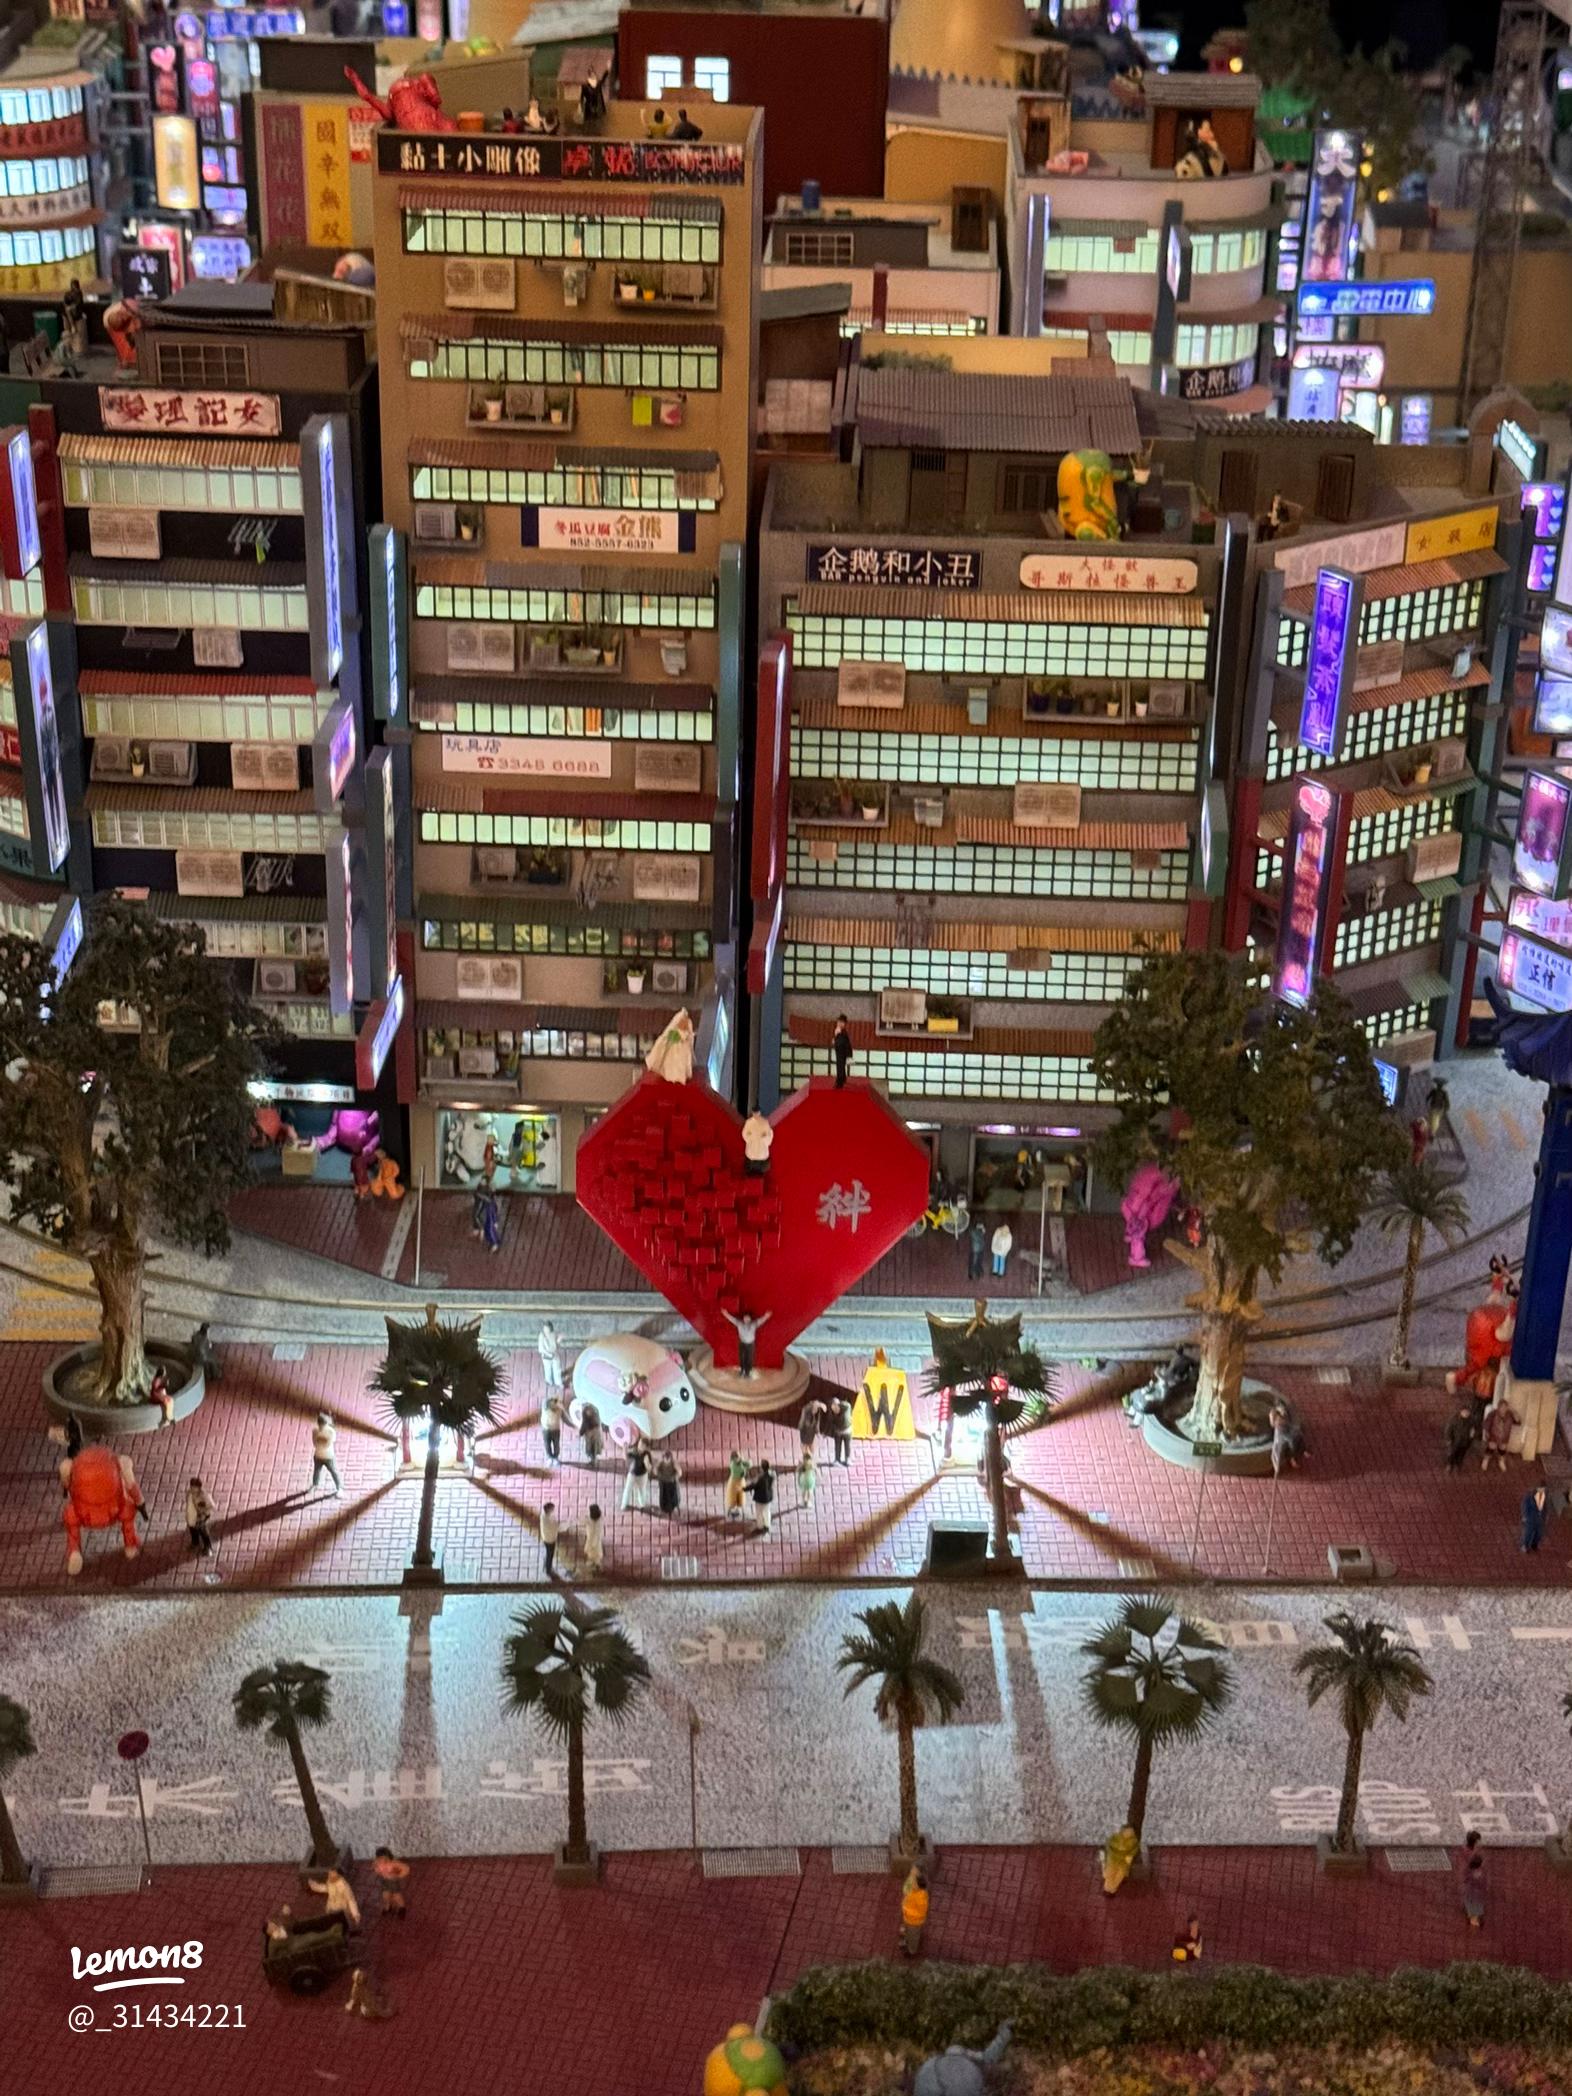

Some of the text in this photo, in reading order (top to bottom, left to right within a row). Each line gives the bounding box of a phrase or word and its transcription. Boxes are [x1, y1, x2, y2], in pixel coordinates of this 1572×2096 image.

[862, 1382, 905, 1436] W
[1269, 1784, 1342, 1831] BUS
[1357, 1780, 1441, 1836] STOP
